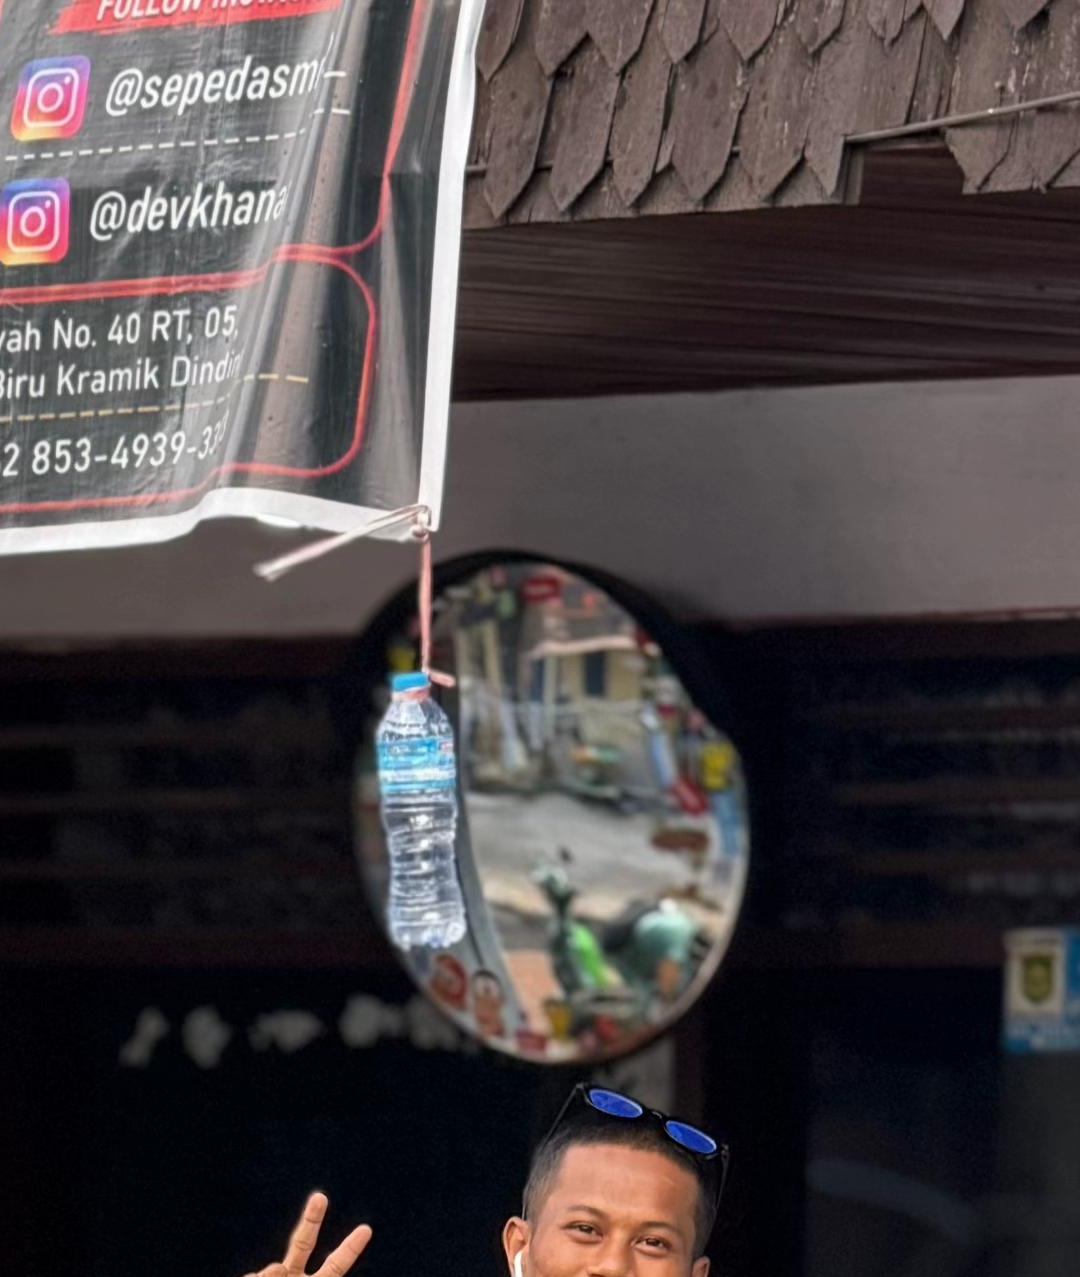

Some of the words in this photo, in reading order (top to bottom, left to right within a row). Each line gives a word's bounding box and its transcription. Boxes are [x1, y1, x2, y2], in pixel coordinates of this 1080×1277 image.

[53, 317, 97, 350] No.
[107, 312, 141, 346] 40
[151, 309, 193, 344] RT,
[56, 357, 160, 396] Kramik
